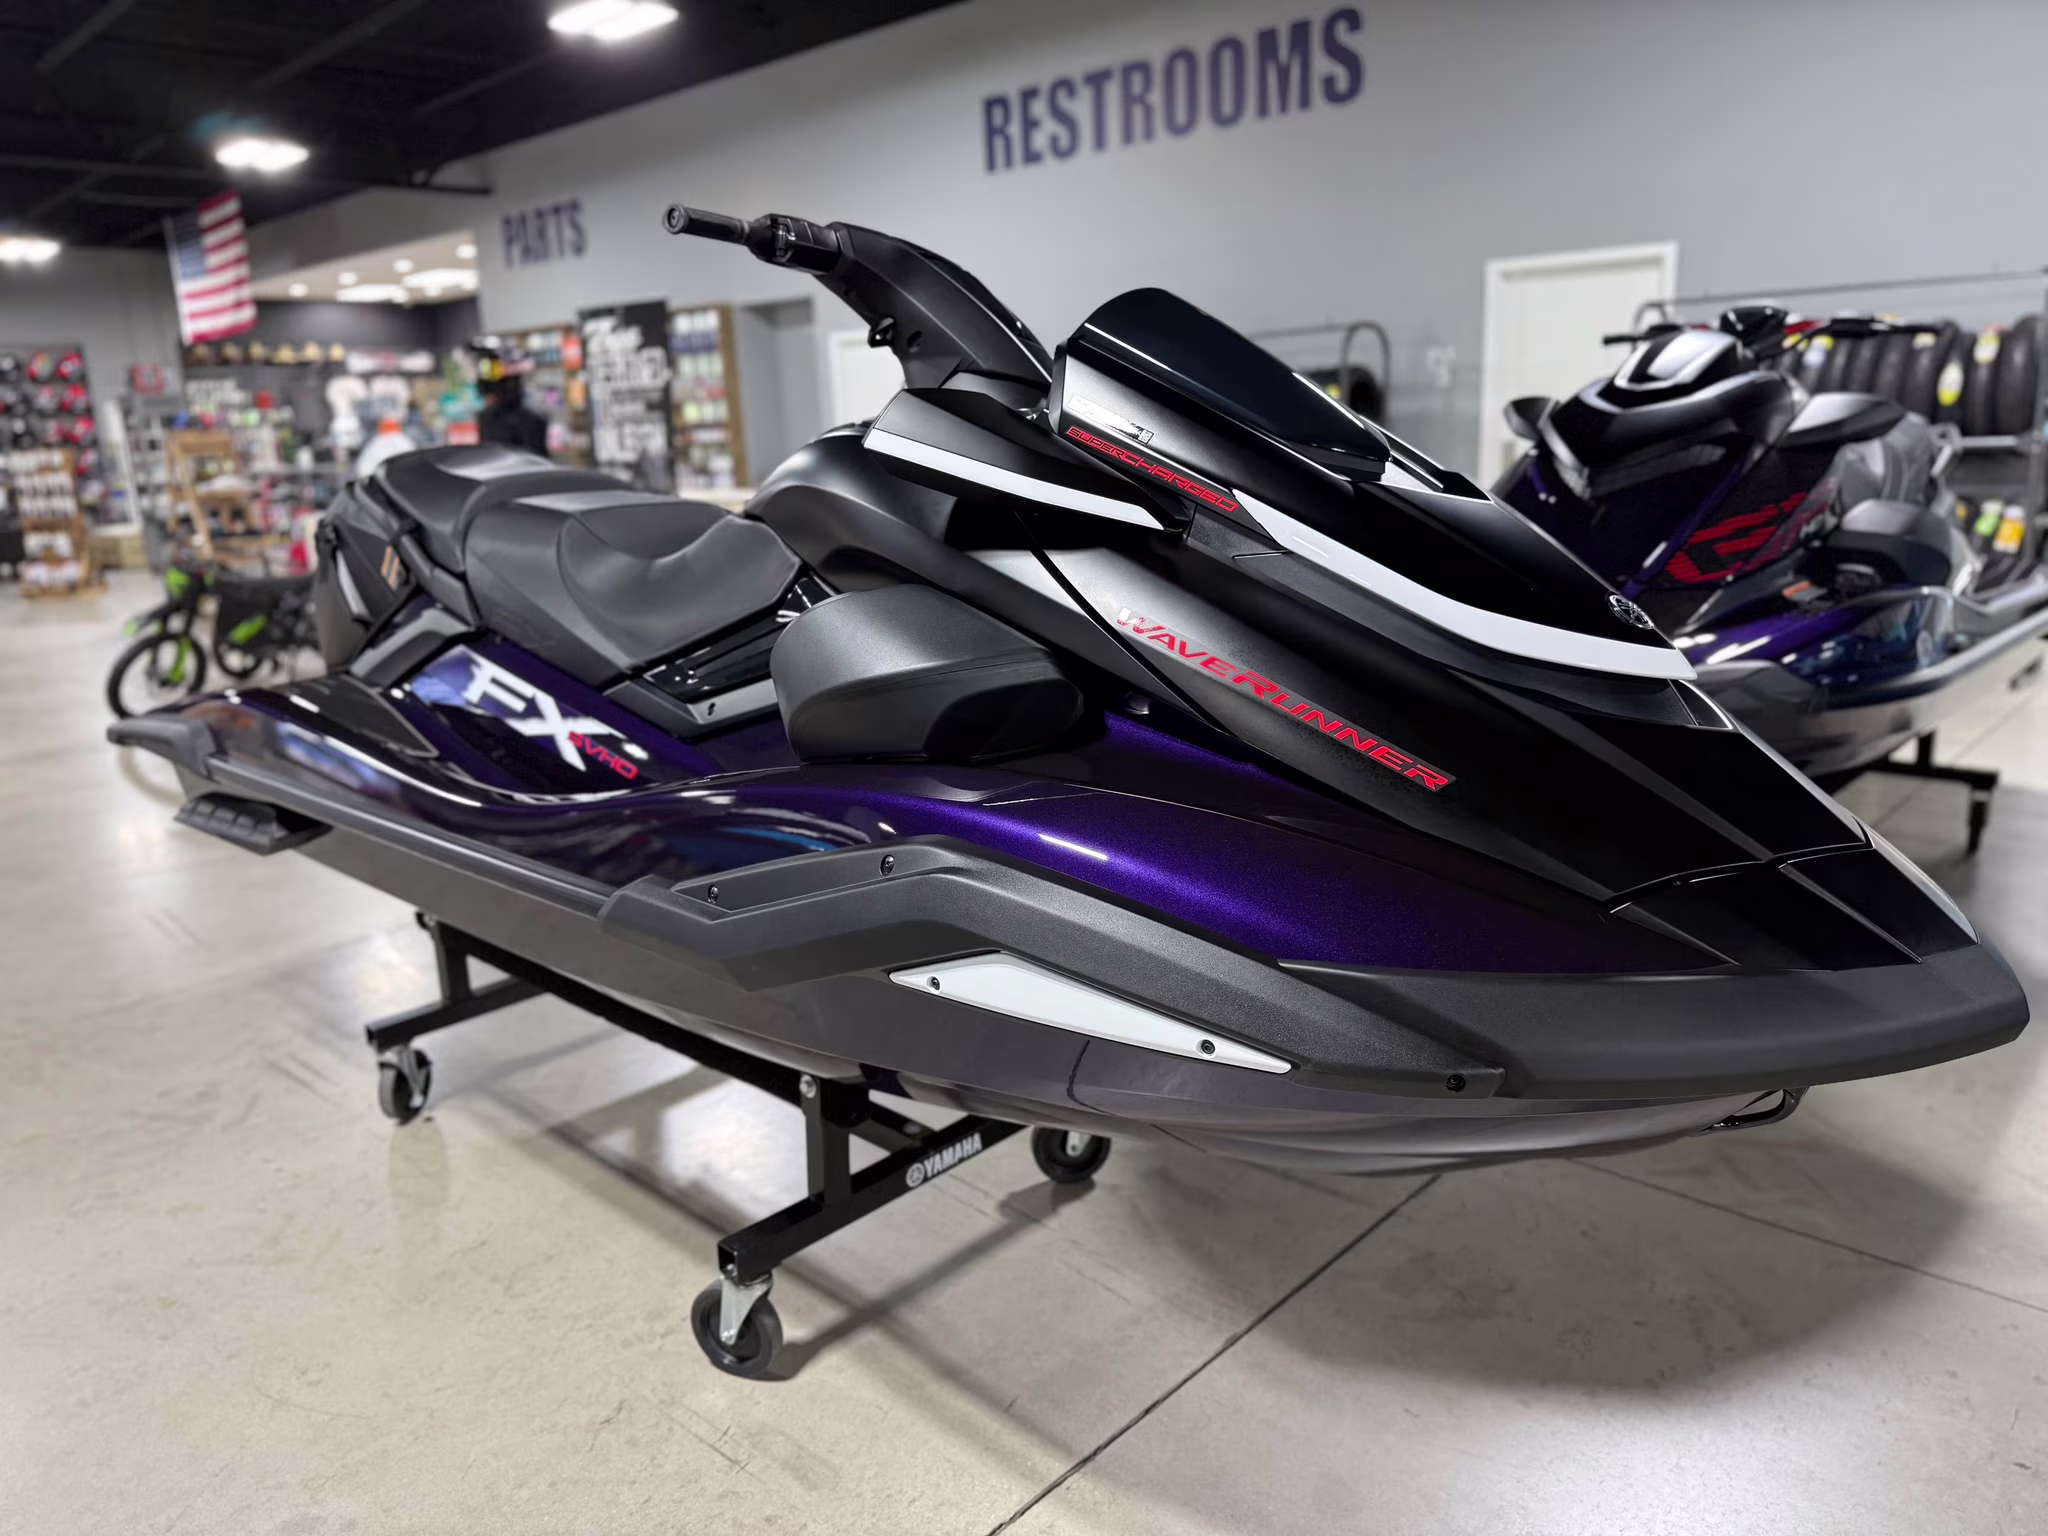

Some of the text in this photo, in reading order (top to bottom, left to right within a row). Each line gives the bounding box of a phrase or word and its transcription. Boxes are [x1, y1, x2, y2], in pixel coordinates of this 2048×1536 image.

[983, 7, 1364, 173] RESTROOMS
[502, 200, 588, 268] PARTS
[1066, 426, 1238, 513] SUPERCHARGED
[462, 658, 613, 772] FX
[1116, 607, 1451, 791] WAVERUNNER
[568, 730, 639, 779] SVHO
[924, 1132, 982, 1178] YAMAHA
